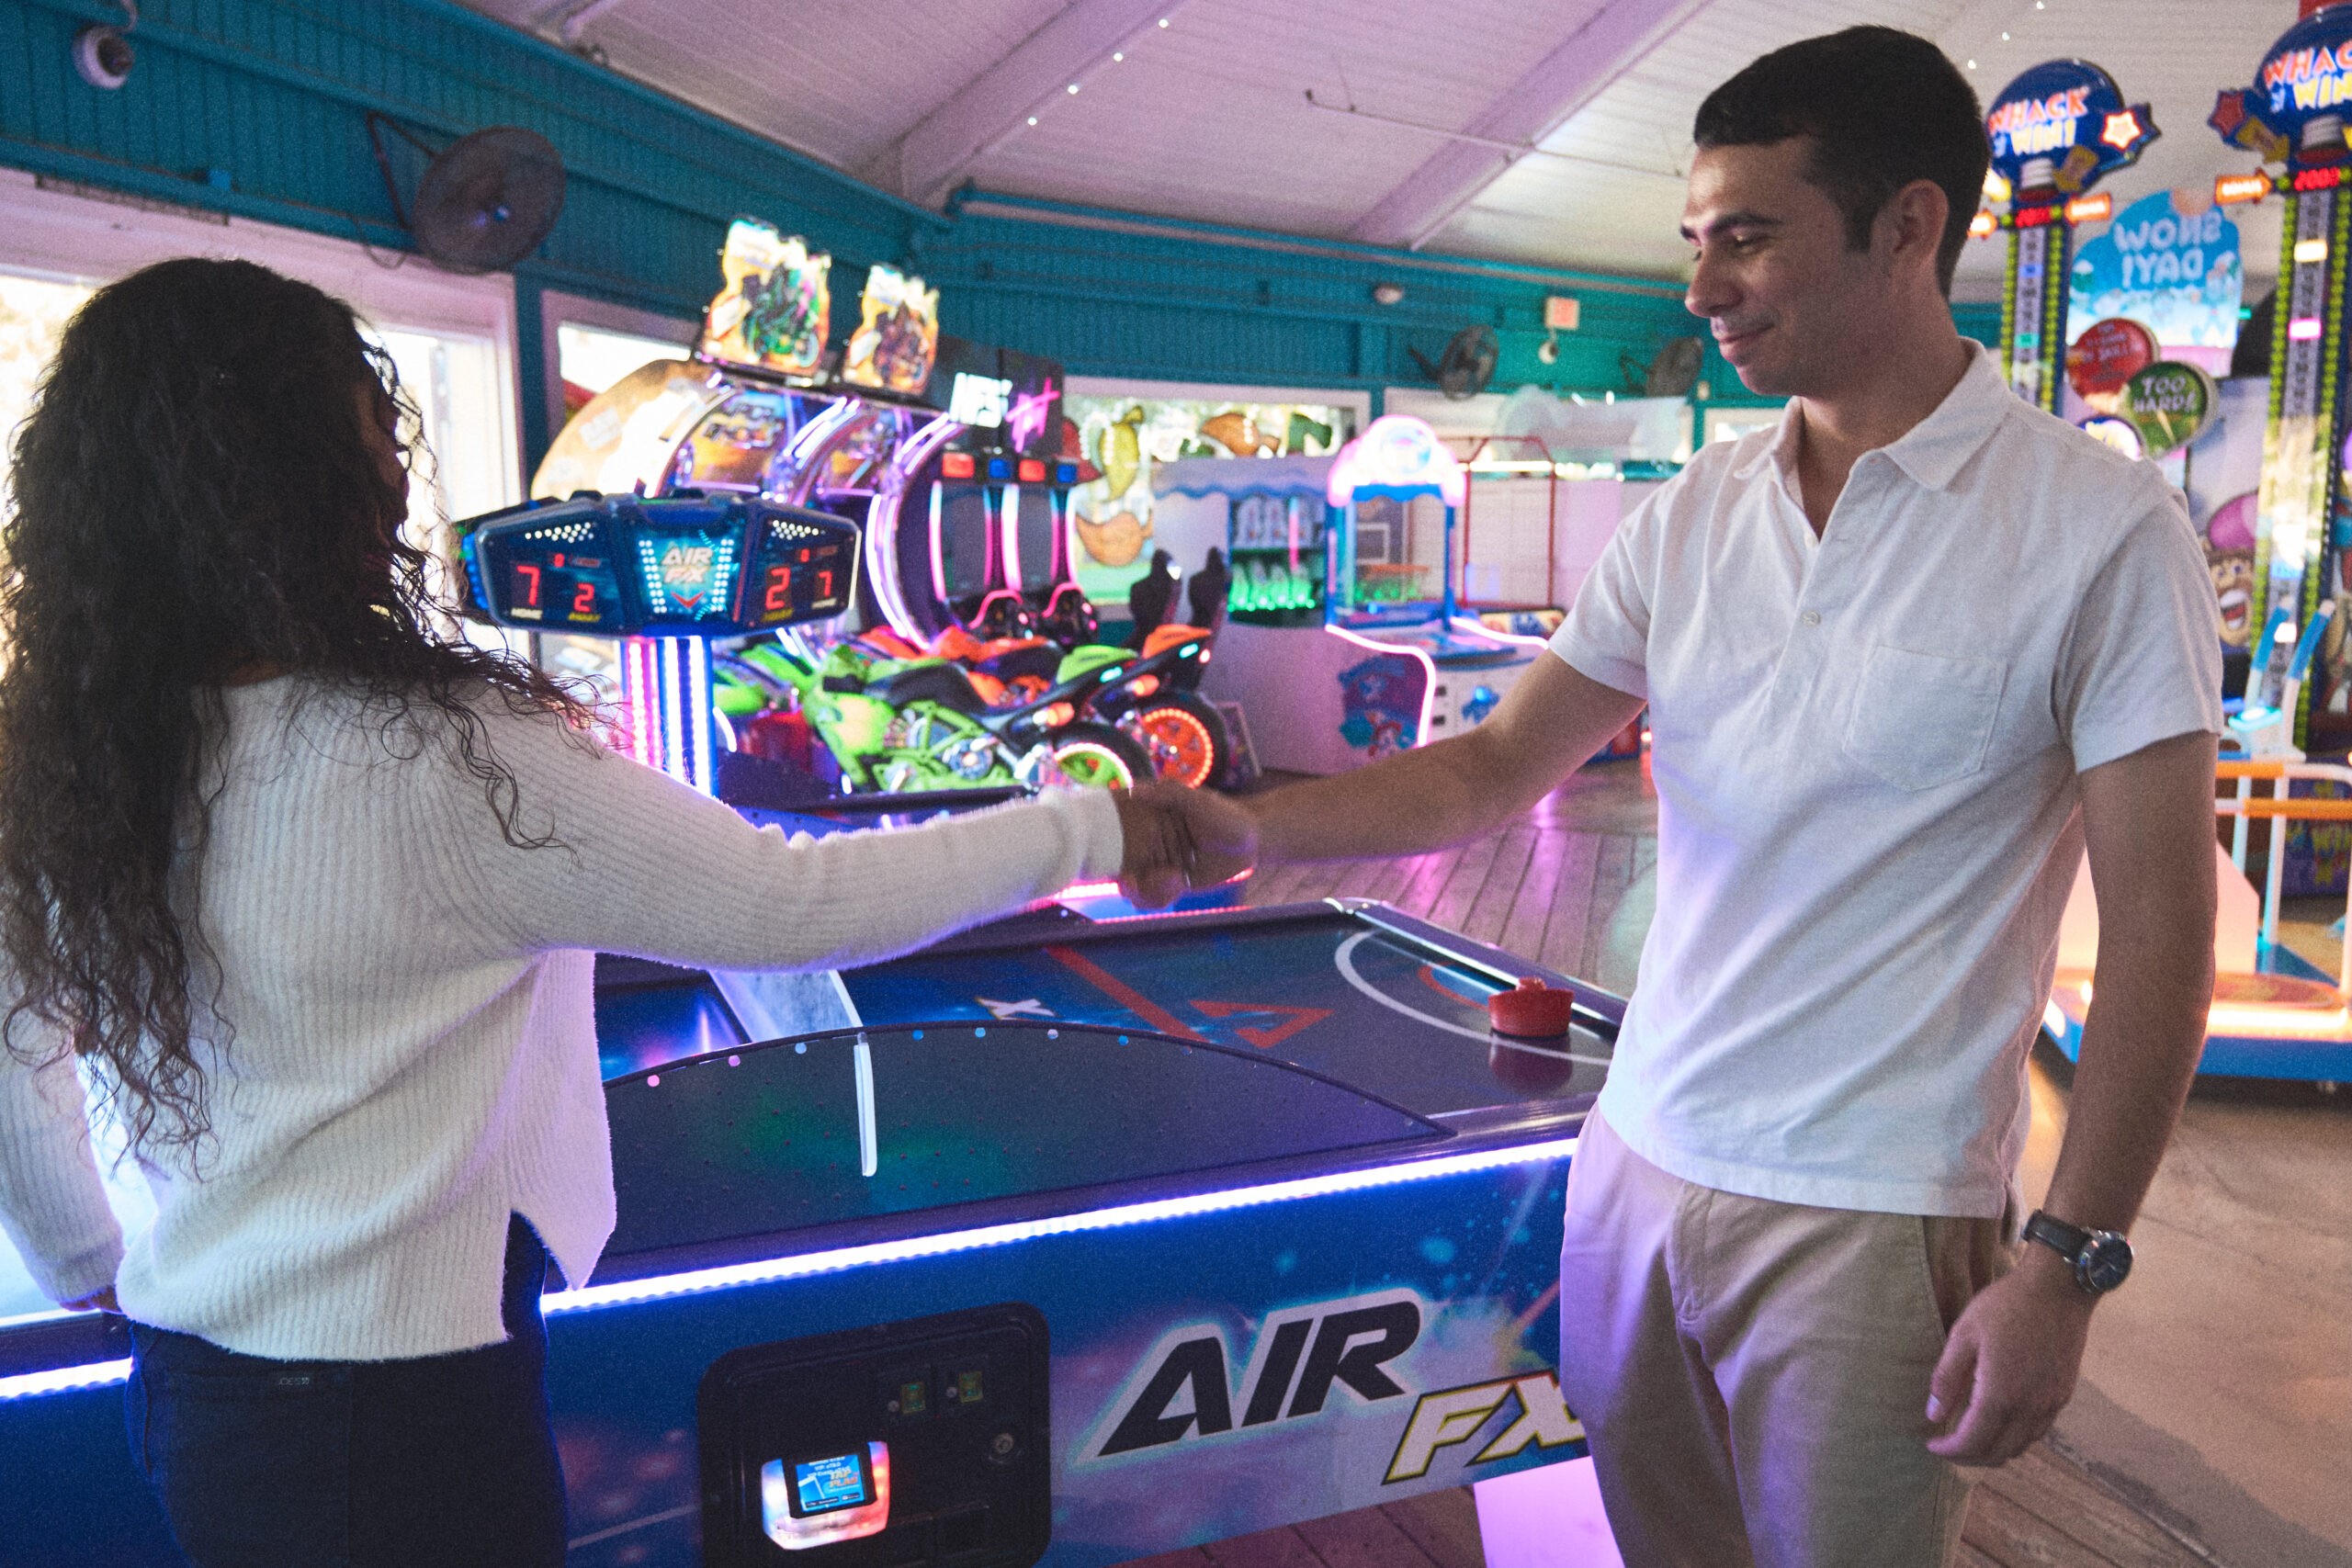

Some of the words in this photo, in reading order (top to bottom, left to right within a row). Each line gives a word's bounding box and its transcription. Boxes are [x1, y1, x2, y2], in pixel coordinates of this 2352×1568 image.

[1988, 85, 2090, 136] WHACK
[2011, 118, 2076, 155] WIN!
[2133, 391, 2197, 413] HARD!
[2142, 376, 2187, 396] TOO
[661, 546, 714, 566] AIR
[663, 564, 710, 584] FX
[516, 565, 540, 606] 7
[573, 582, 594, 613] 2
[764, 567, 790, 610] 2
[1084, 1292, 1422, 1462] AIR
[1381, 1369, 1588, 1486] FX
